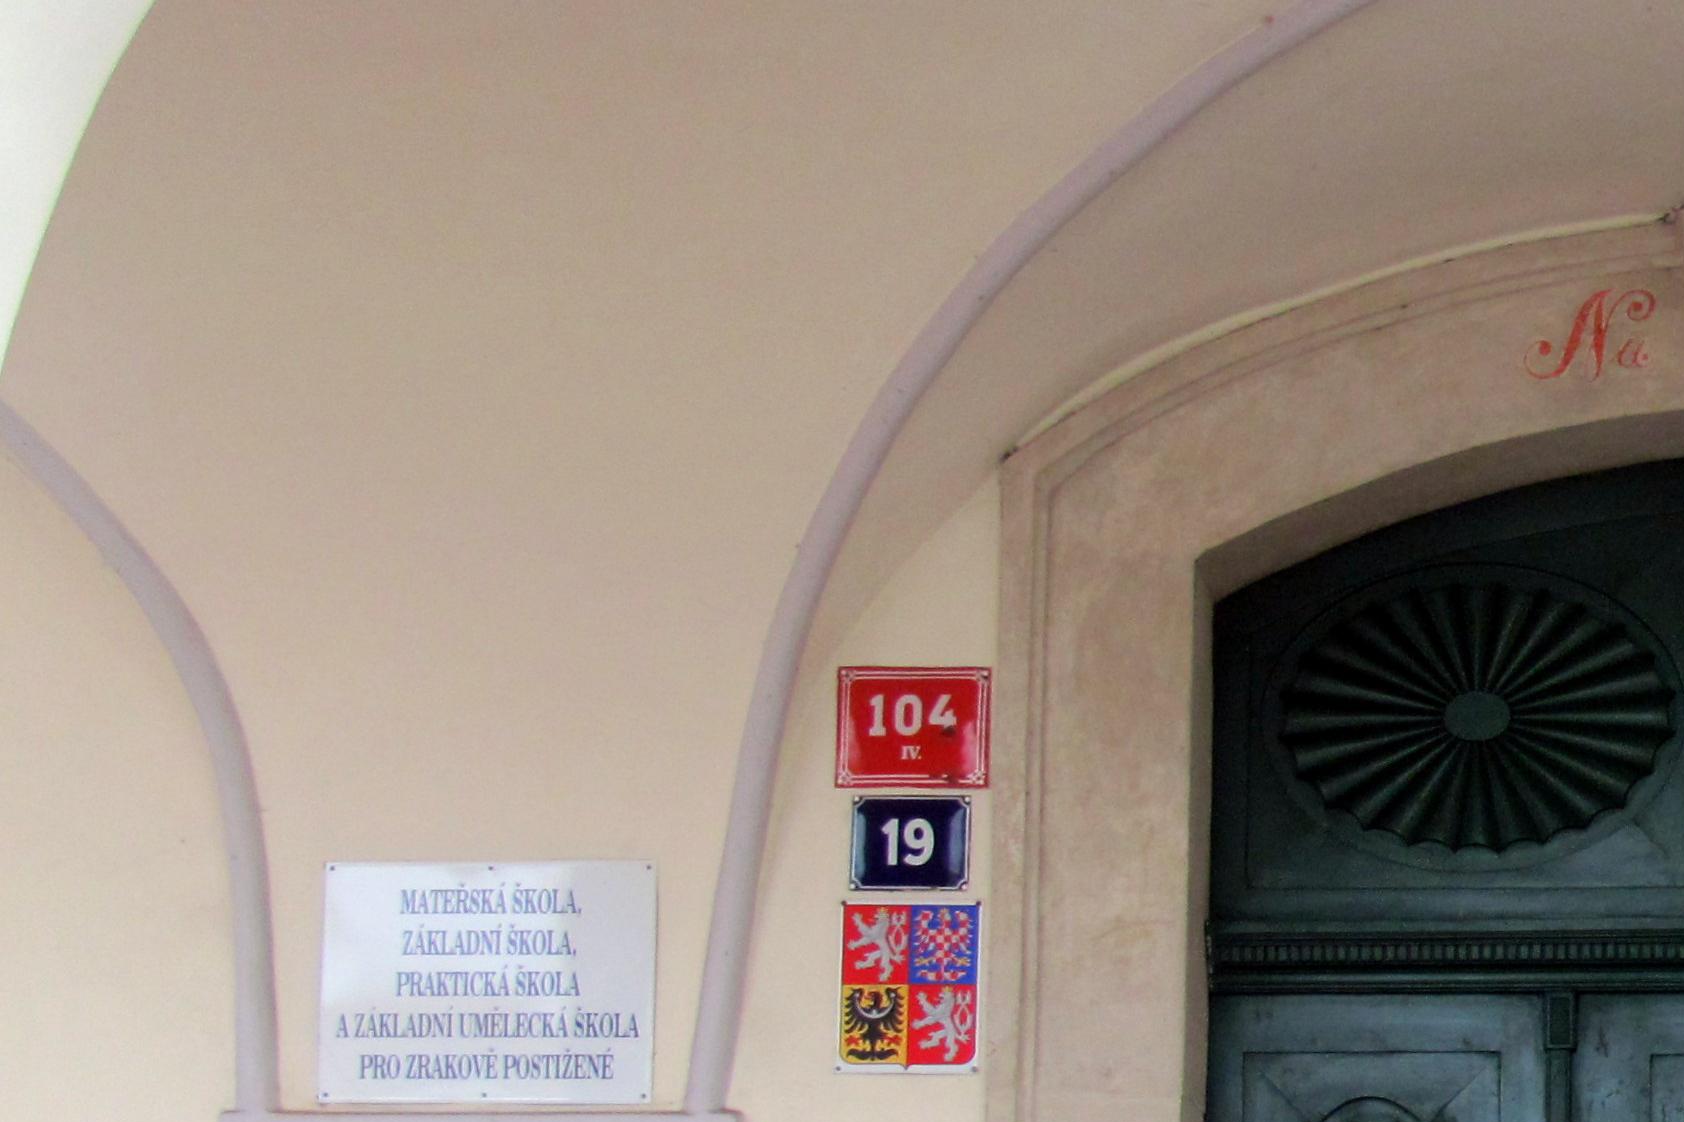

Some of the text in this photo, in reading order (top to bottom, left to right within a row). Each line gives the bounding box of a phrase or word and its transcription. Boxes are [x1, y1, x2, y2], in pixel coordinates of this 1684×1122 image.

[868, 694, 958, 737] 104
[901, 745, 922, 760] IV.
[880, 817, 935, 867] 19
[400, 882, 582, 915] MATEŘSKÁ ŠKOLA,
[402, 924, 577, 957] ZÁKLADNÍ ŠKOLA,
[395, 965, 581, 997] PRAKTICKÁ ŠKOLA
[335, 1006, 640, 1038] A ZÁKLADNÍ UMĚLECKÁ ŠKOLA
[359, 1047, 615, 1080] PRO ZRAKOVĚ POSTIŽENÉ
